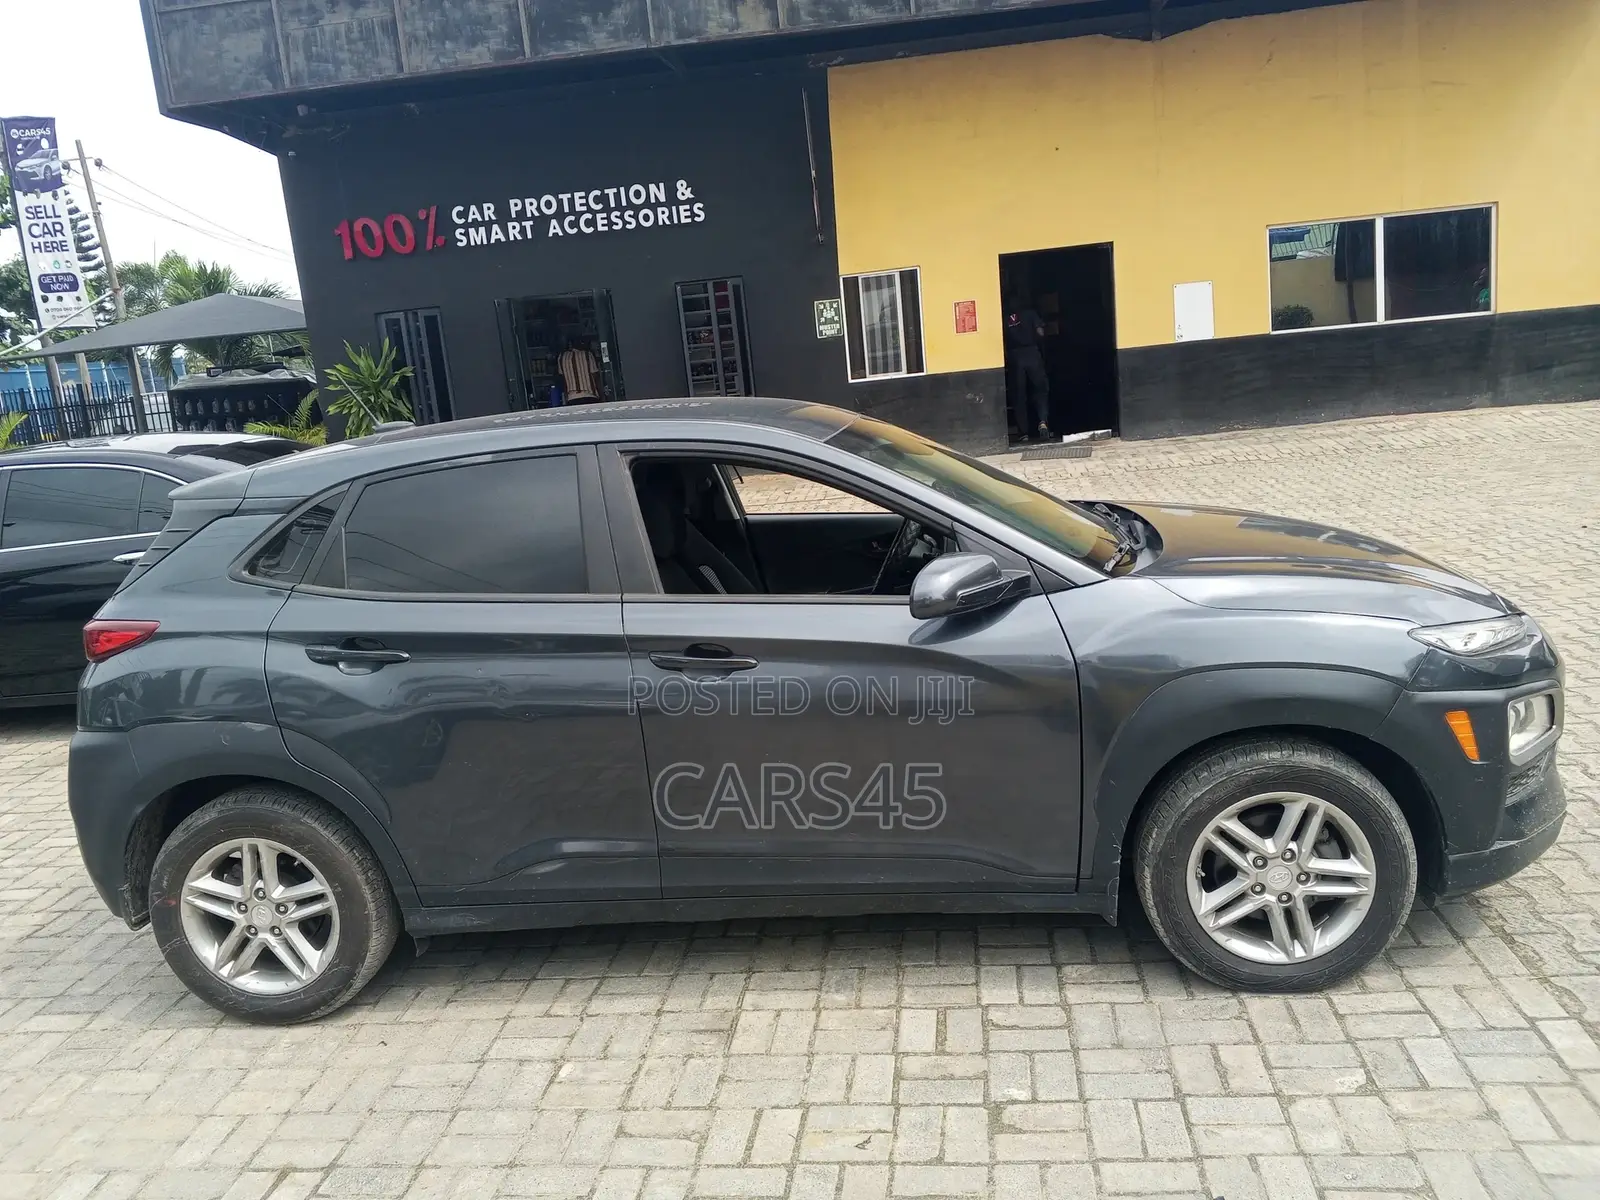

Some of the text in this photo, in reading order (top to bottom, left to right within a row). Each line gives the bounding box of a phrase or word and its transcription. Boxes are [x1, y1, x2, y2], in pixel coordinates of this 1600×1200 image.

[19, 127, 51, 137] CARS45
[451, 179, 695, 225] CAR PROTECTION &
[25, 205, 62, 220] SELL
[27, 221, 66, 239] CAR
[334, 205, 447, 261] 100%
[454, 203, 706, 248] SMART ACCESSORIES
[31, 240, 70, 254] HERE
[40, 275, 57, 284] GET
[50, 282, 70, 291] NOW
